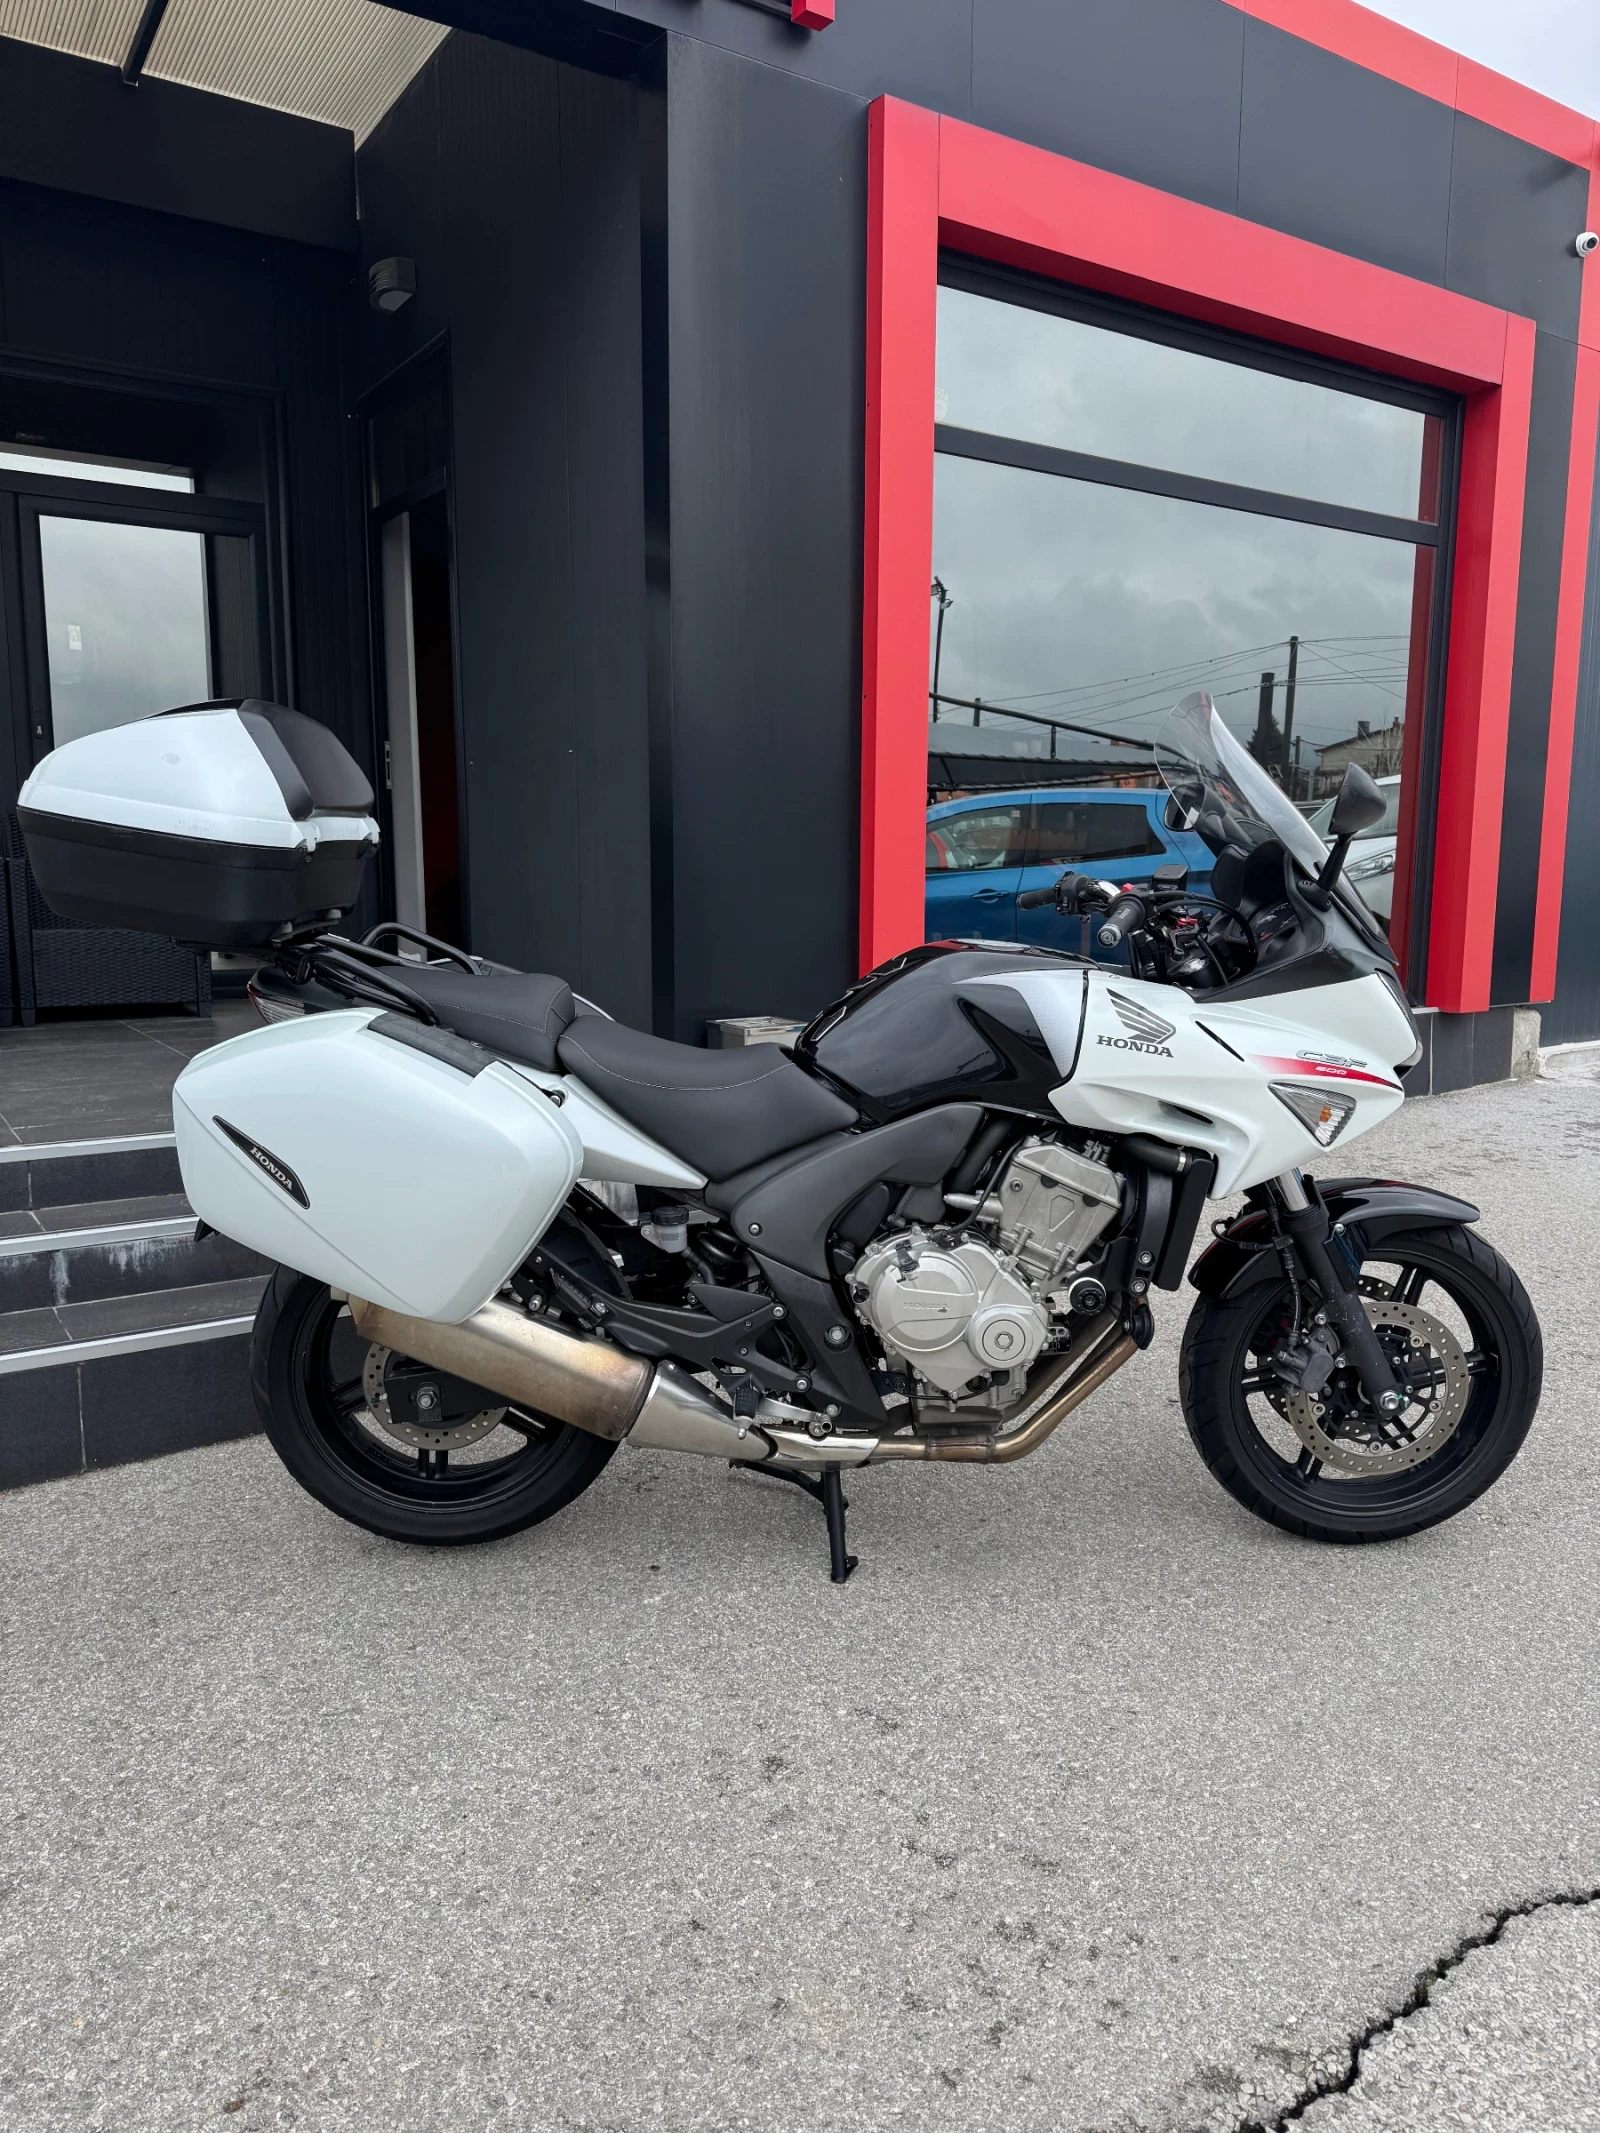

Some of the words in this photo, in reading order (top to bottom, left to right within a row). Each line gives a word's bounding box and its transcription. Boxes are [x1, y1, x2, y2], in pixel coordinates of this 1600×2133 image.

[1096, 1034, 1175, 1059] HONDA
[1295, 1049, 1368, 1069] CBF
[1315, 1065, 1348, 1076] 600
[250, 1146, 293, 1191] HONDA
[902, 1301, 950, 1311] HONDA
